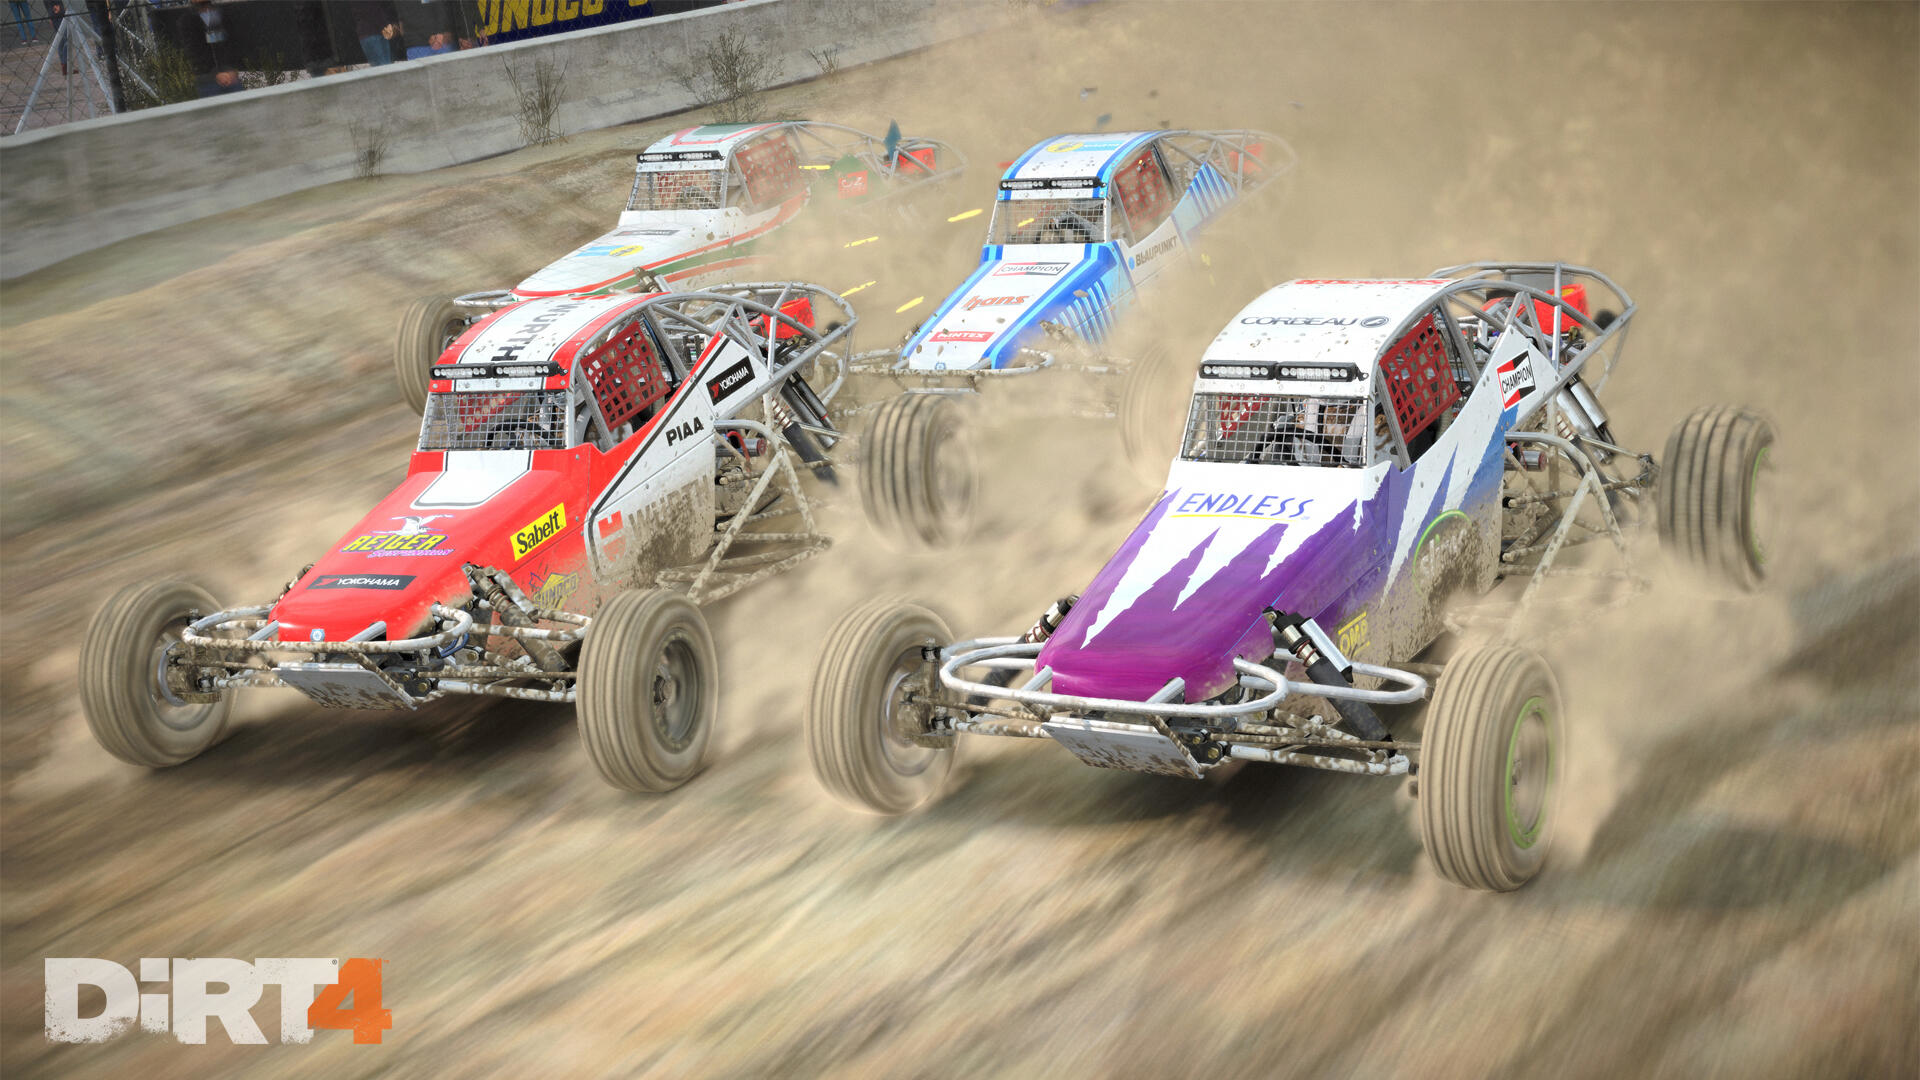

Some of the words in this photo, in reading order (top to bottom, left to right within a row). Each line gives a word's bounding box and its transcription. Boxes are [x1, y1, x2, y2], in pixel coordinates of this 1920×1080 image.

[1135, 235, 1178, 267] BLAUPUNKT
[1001, 265, 1062, 273] CHAMPION
[1241, 317, 1358, 326] CORBEAU
[719, 366, 749, 391] YOKOHAMA
[1501, 364, 1533, 394] CHAMPION
[665, 416, 705, 447] PIAA
[1176, 493, 1314, 518] ENDLESS
[341, 535, 447, 552] REIGER
[517, 511, 560, 554] Sabelt
[337, 577, 400, 586] YOKOHAMA
